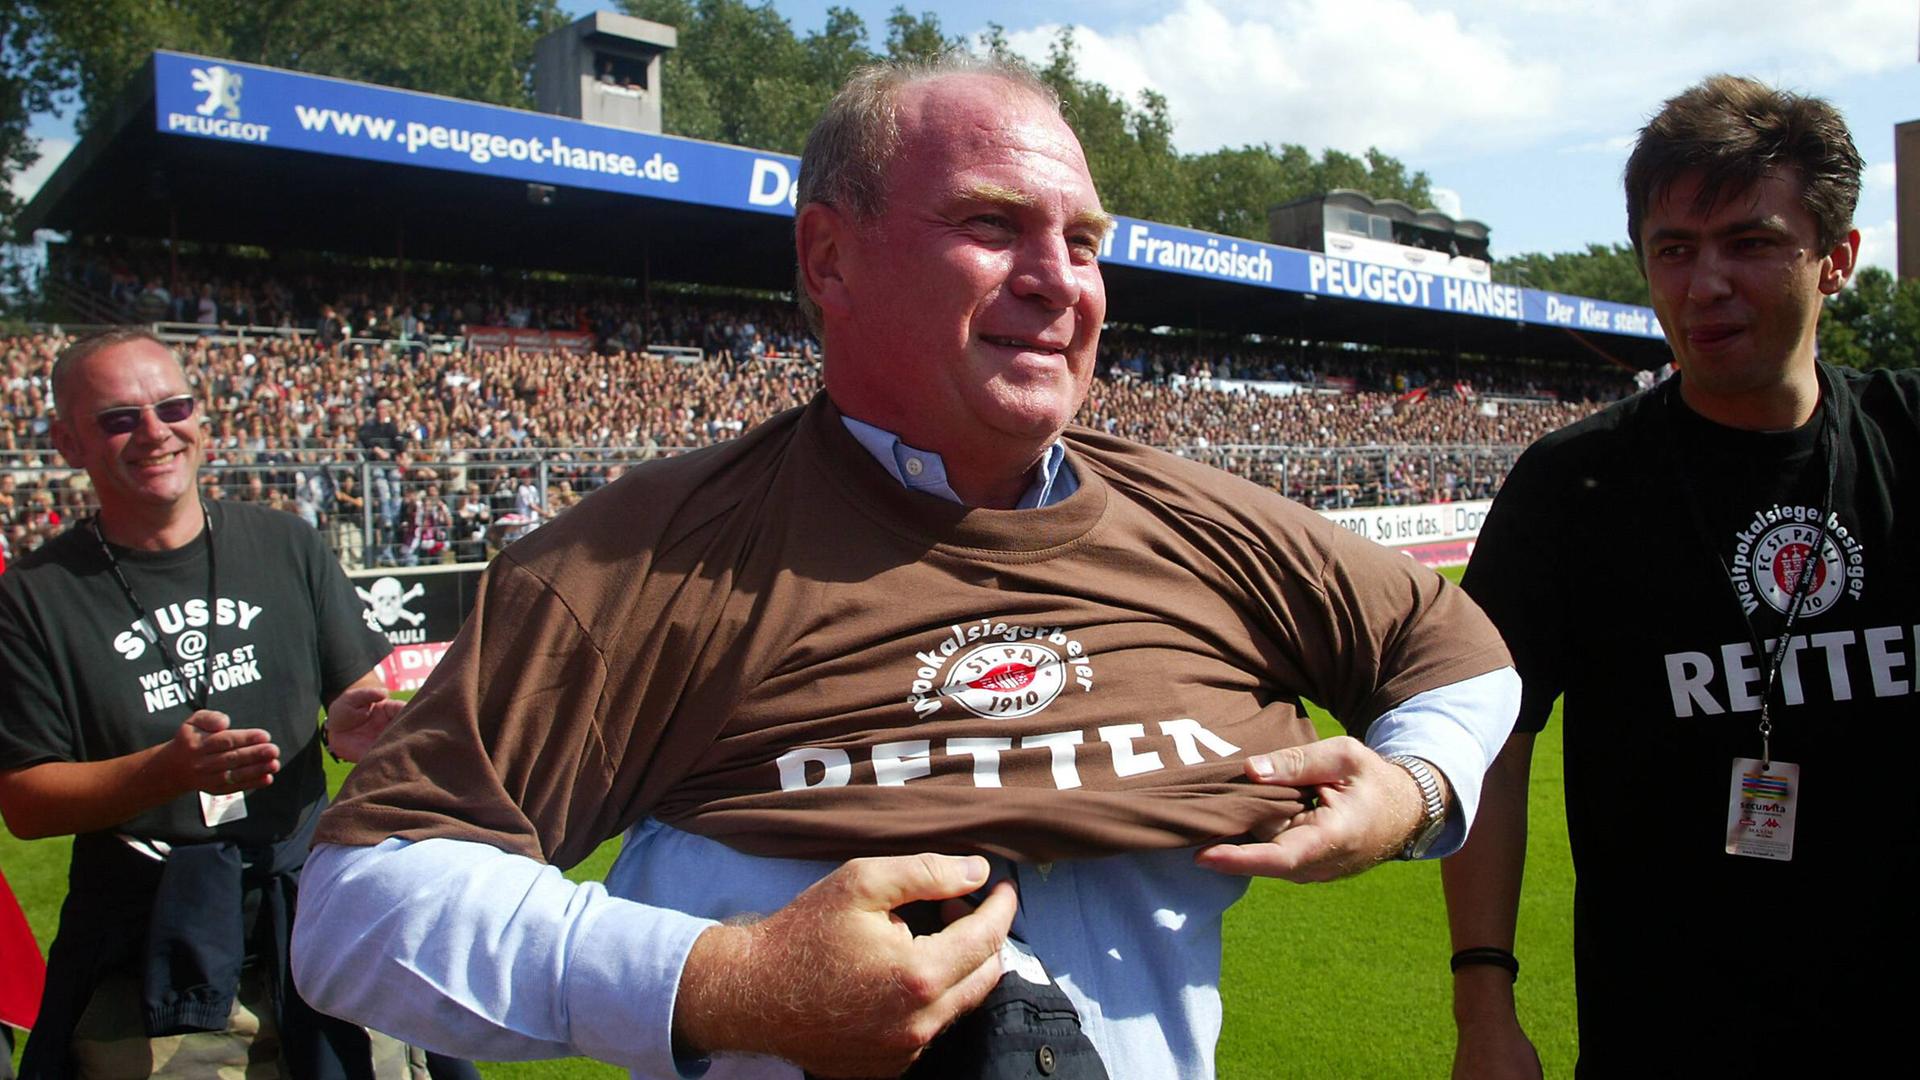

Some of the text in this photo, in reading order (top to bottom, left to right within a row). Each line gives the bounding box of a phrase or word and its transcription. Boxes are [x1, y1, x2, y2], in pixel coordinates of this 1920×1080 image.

[168, 112, 271, 142] PEUGEOT
[295, 105, 680, 183] www.peugeot-hanse.de
[1128, 224, 1272, 282] Französisch
[1308, 254, 1434, 308] PEUGEOT
[1546, 296, 1575, 324] Der
[1580, 300, 1607, 330] Kiez
[1613, 309, 1647, 334] steht
[1376, 517, 1392, 540] So
[1396, 514, 1412, 538] ist
[1416, 513, 1440, 536] das.
[1758, 554, 1772, 571] FC
[1793, 528, 1839, 565] PALI
[176, 630, 207, 660] @
[385, 628, 426, 645] AULI
[232, 644, 255, 664] ST
[1664, 624, 1920, 718] RETTE
[988, 691, 1038, 712] 1910
